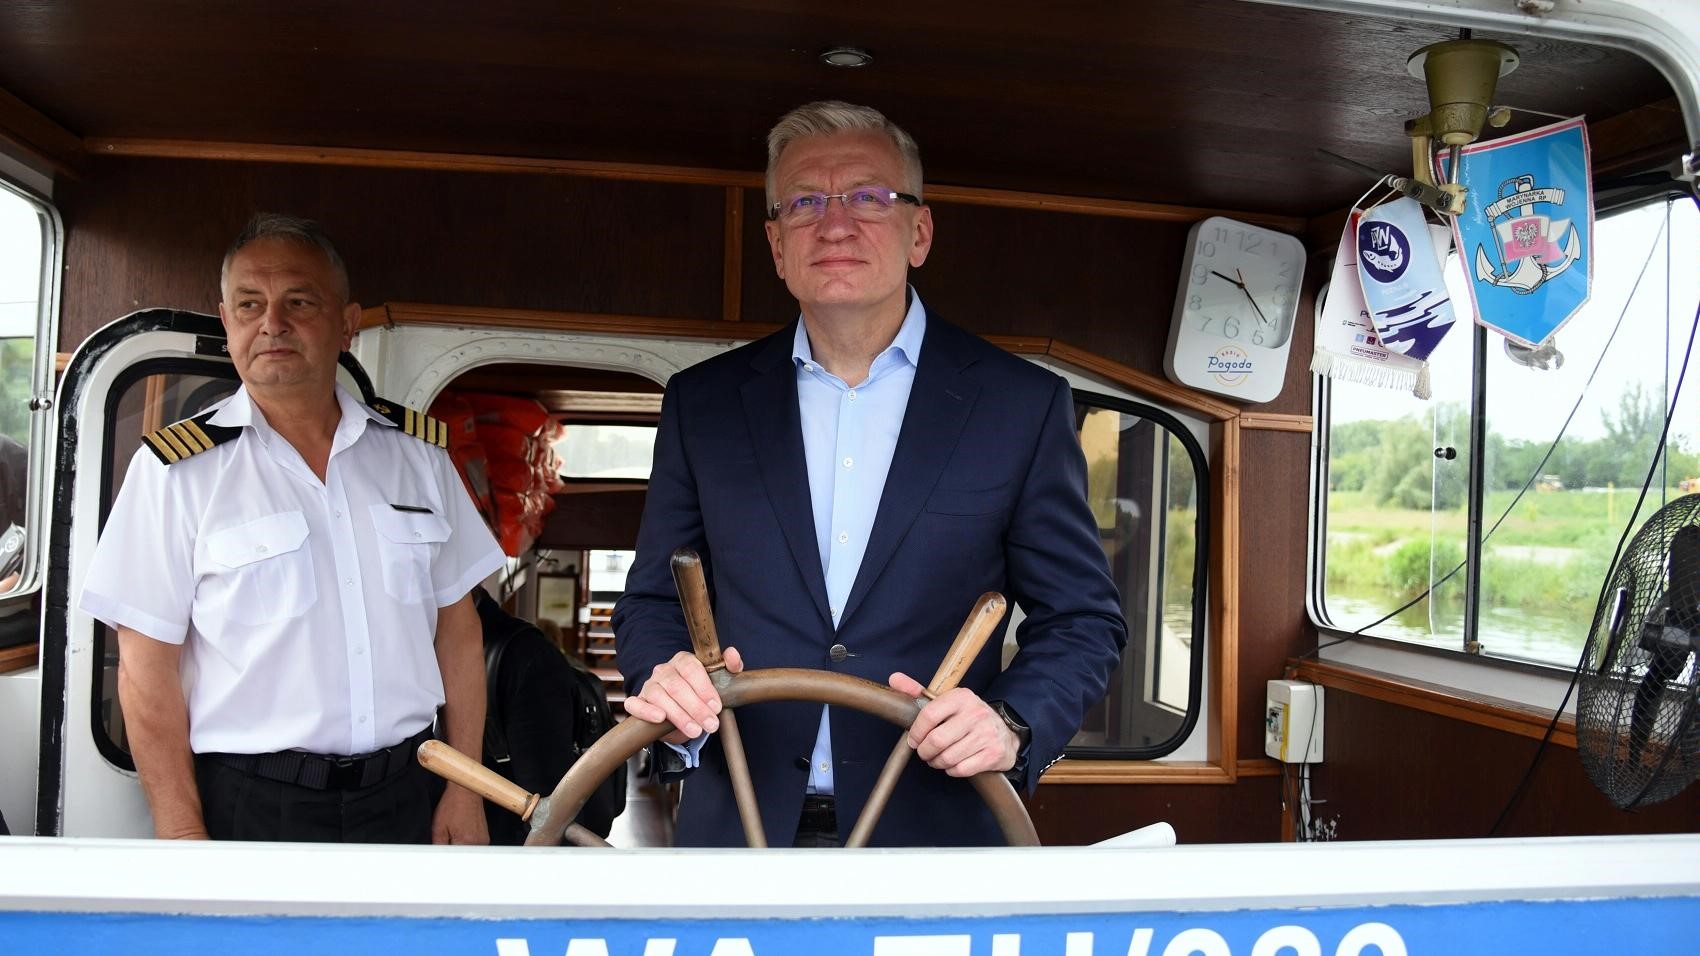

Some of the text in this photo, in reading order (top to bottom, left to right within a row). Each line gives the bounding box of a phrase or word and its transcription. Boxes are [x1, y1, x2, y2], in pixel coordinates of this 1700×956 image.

[1505, 197, 1536, 209] WOJENNA
[1506, 190, 1545, 203] MARYNARKA
[1215, 227, 1228, 243] 11
[1237, 231, 1260, 255] 12
[1198, 240, 1216, 258] 10
[1270, 242, 1278, 257] 1
[1192, 263, 1207, 286] 9
[1280, 262, 1291, 278] 2
[1189, 295, 1202, 311] 8
[1272, 284, 1286, 307] 3
[1201, 317, 1213, 332] 7
[1223, 316, 1240, 338] 6
[1268, 318, 1278, 331] 4
[1251, 330, 1264, 346] 5
[1352, 347, 1387, 358] PNEUMASTER
[1207, 356, 1252, 373] Pogoda
